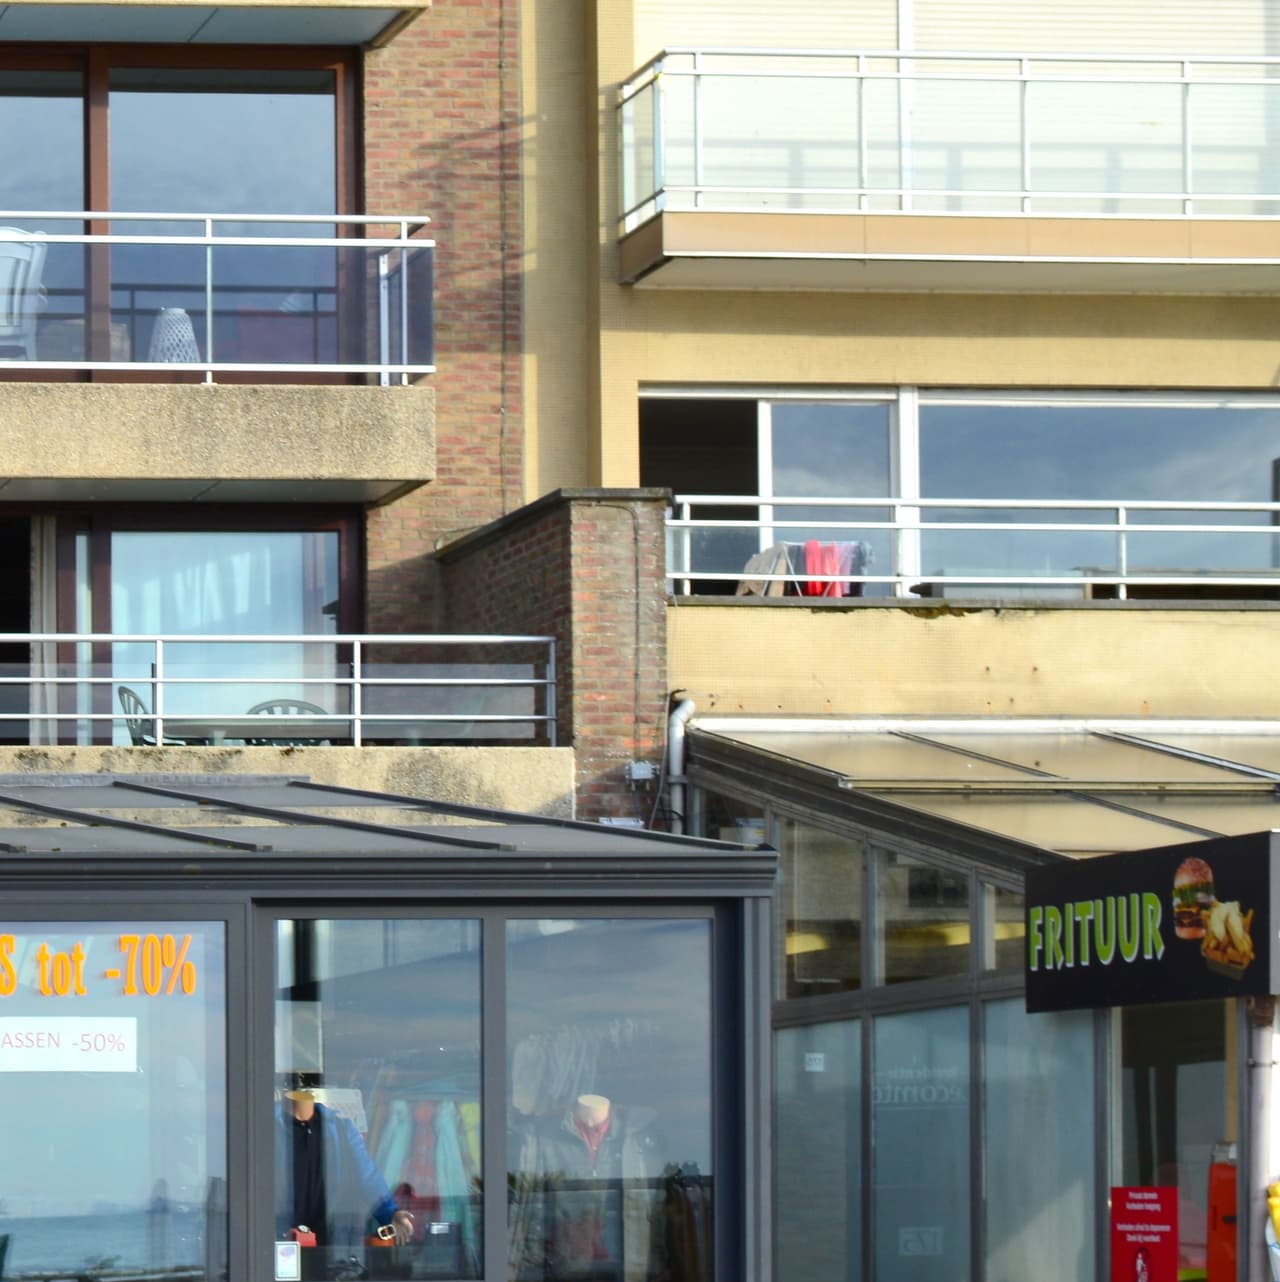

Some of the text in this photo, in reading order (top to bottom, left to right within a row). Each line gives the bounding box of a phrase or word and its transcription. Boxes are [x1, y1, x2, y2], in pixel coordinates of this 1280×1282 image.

[1029, 892, 1165, 971] FRITUUR
[36, 942, 87, 996] tot
[104, 934, 196, 995] -70%
[71, 1033, 126, 1051] -50%
